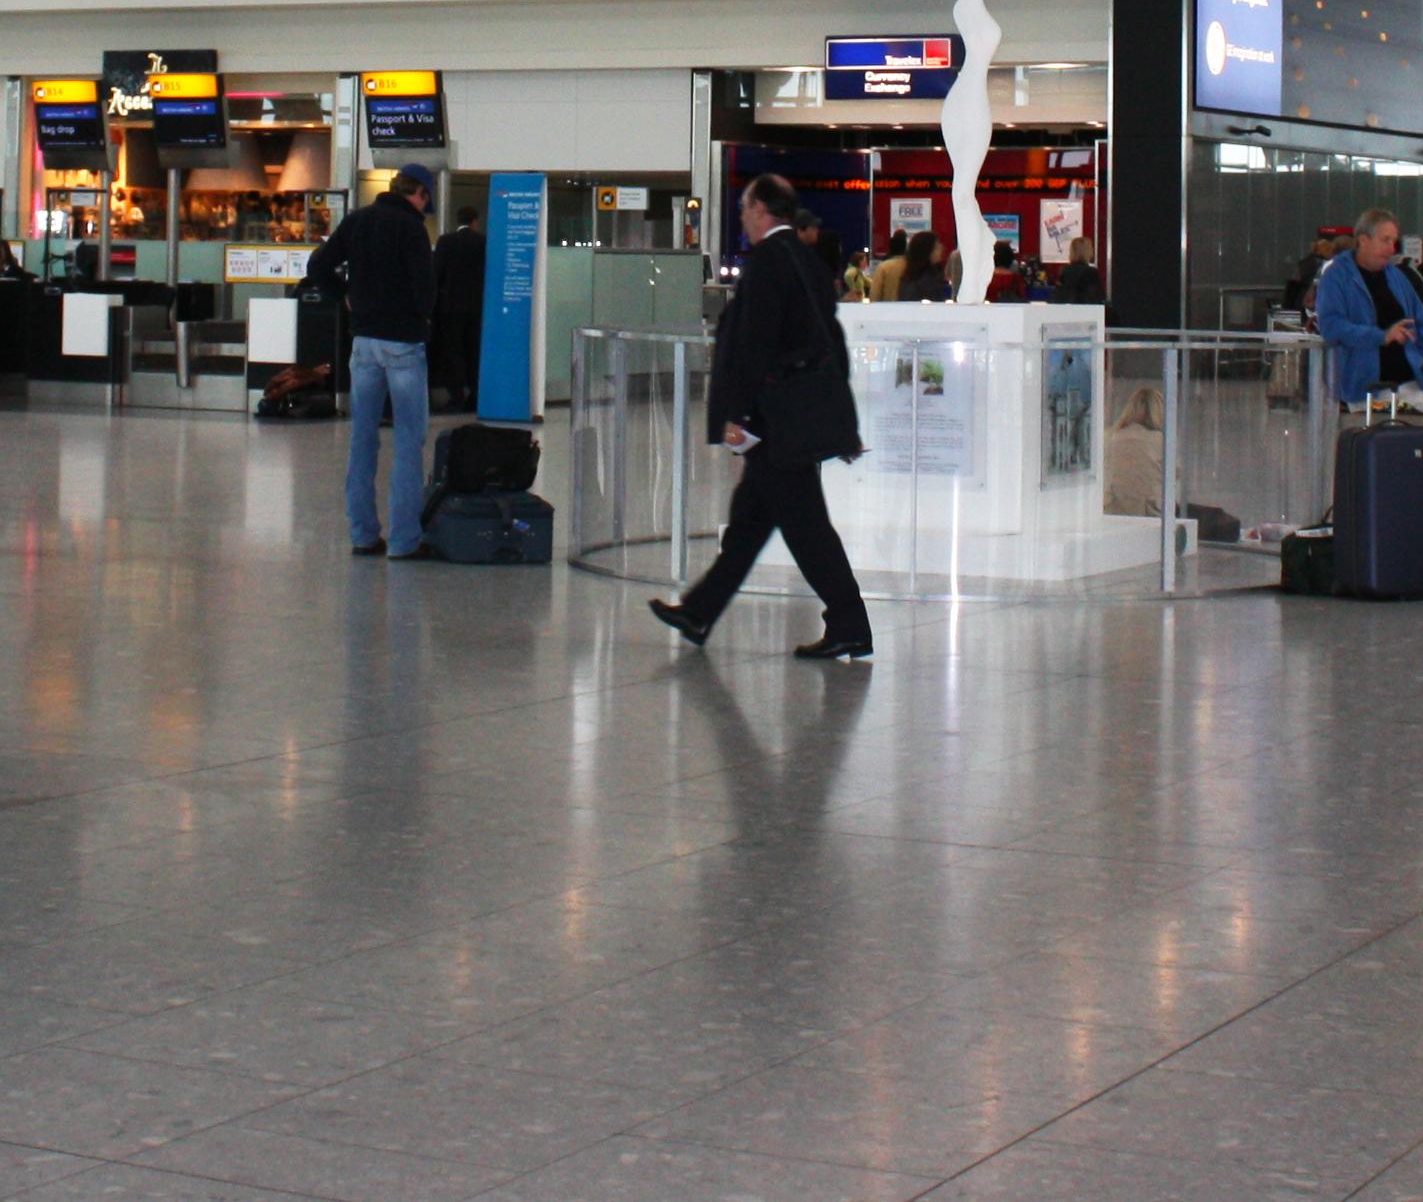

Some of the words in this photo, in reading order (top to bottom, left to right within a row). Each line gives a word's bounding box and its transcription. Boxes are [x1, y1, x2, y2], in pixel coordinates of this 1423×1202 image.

[864, 70, 911, 83] Currency
[163, 81, 181, 91] B15
[378, 78, 397, 88] B16
[46, 87, 64, 96] B14
[864, 82, 911, 95] Exchange
[371, 114, 406, 125] Passport
[408, 113, 415, 123] &
[416, 114, 435, 124] Visa
[371, 126, 396, 136] check
